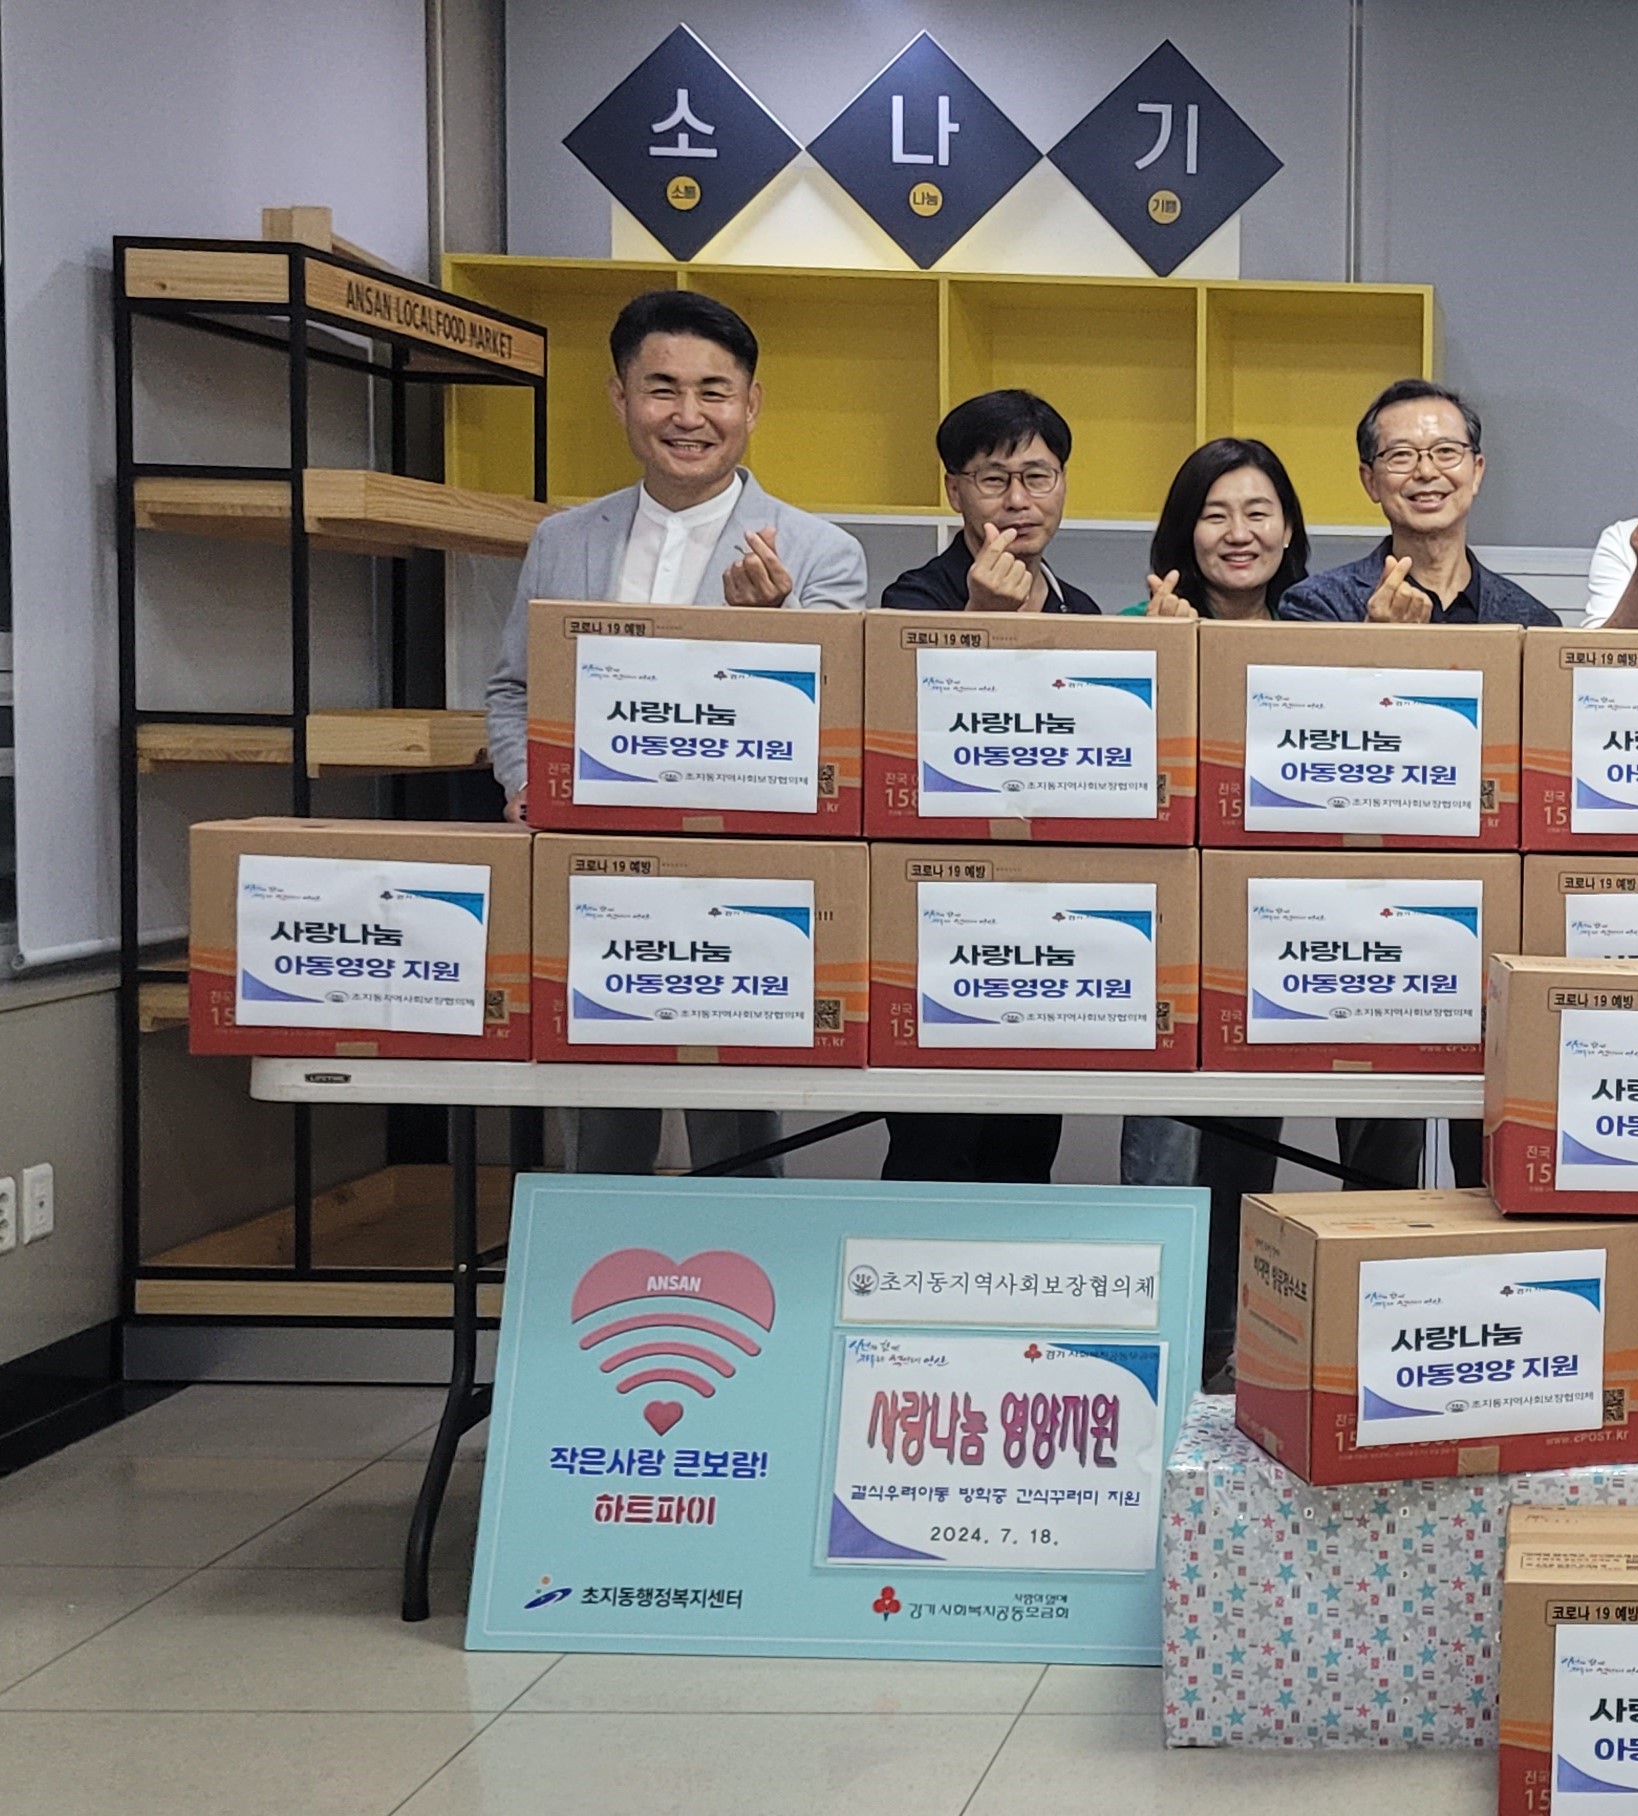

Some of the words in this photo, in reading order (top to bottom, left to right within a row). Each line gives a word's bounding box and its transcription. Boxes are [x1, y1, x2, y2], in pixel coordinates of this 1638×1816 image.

[648, 88, 718, 158] 소
[890, 94, 959, 166] 나
[1134, 102, 1199, 174] 기
[346, 281, 391, 321] ANSAN
[469, 328, 512, 360] MARKET
[569, 622, 601, 633] 코로나
[608, 623, 620, 634] 19
[625, 623, 646, 636] 예방
[906, 633, 938, 645] 코로나
[944, 633, 956, 645] 19
[960, 634, 981, 646] 예방
[1565, 653, 1596, 665] 코로나
[1601, 653, 1613, 665] 19
[1617, 654, 1637, 666] 예방
[607, 701, 736, 726] 사랑나눔
[949, 713, 1075, 734] 사랑나눔
[611, 735, 728, 759] 아동영양
[735, 740, 793, 761] 지원
[1277, 729, 1401, 751] 사랑나눔
[954, 747, 1068, 766] 아동영양
[1076, 748, 1132, 767] 지원
[1281, 763, 1394, 784] 아동영양
[1401, 766, 1456, 785] 지원
[574, 860, 607, 872] 코로나
[613, 861, 625, 873] 19
[630, 861, 651, 874] 예방
[911, 865, 943, 877] 코로나
[948, 865, 961, 877] 19
[965, 866, 985, 878] 예방
[1564, 877, 1595, 889] 코로나
[1600, 878, 1612, 889] 19
[1616, 878, 1636, 891] 예방
[270, 922, 403, 946] 사랑나눔
[602, 940, 731, 962] 사랑나눔
[949, 945, 1075, 966] 사랑나눔
[1278, 941, 1402, 962] 사랑나눔
[275, 956, 395, 978] 아동영양
[402, 960, 460, 982] 지원
[606, 974, 724, 995] 아동영양
[731, 976, 788, 996] 지원
[954, 979, 1068, 999] 아동영양
[1076, 979, 1131, 999] 지원
[1283, 975, 1395, 993] 아동영양
[1402, 975, 1457, 993] 지원
[1554, 994, 1588, 1007] 코로나
[1595, 995, 1607, 1007] 19
[1612, 995, 1634, 1009] 예방
[647, 1276, 701, 1292] ANSAN
[880, 1271, 1154, 1299] 초지동지역사회보장협의체
[1391, 1323, 1523, 1353] 사랑나눔
[1397, 1359, 1515, 1388] 아동영양
[1522, 1355, 1578, 1379] 지원
[867, 1390, 988, 1466] 사랑나눔
[1001, 1392, 1119, 1469] 영양지원
[550, 1448, 666, 1476] 작은사랑
[674, 1450, 768, 1478] 큰보람!
[959, 1488, 1007, 1504] 방학중
[1017, 1488, 1098, 1505] 간식꾸러미
[1108, 1491, 1140, 1506] 지원
[594, 1494, 716, 1525] 하트파이
[930, 1527, 989, 1544] 2024.
[1001, 1529, 1017, 1544] 7.
[1031, 1529, 1058, 1546] 18.
[581, 1587, 743, 1609] 초지동행정복지센터
[1552, 1606, 1590, 1620] 코로나
[1596, 1606, 1609, 1620] 19
